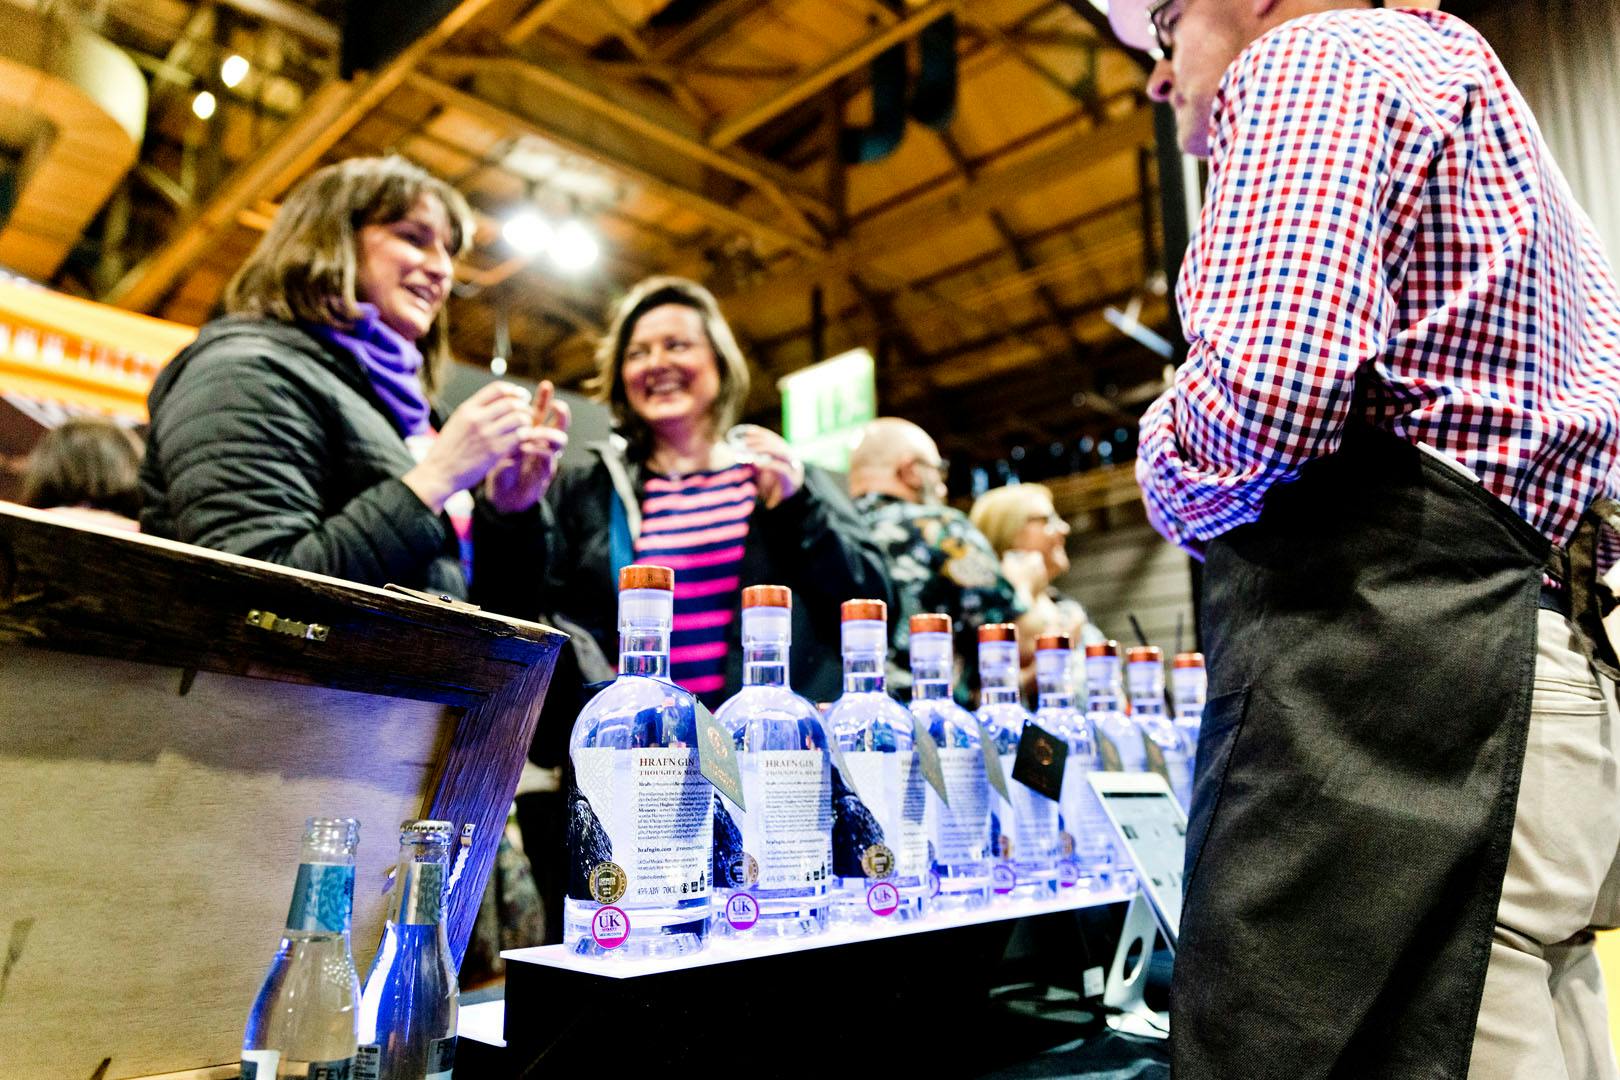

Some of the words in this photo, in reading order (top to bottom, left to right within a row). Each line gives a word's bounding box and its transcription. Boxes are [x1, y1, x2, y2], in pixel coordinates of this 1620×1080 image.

[640, 758, 676, 766] HRAFN
[677, 758, 695, 766] GIN
[732, 901, 751, 912] UK
[599, 914, 621, 928] UK
